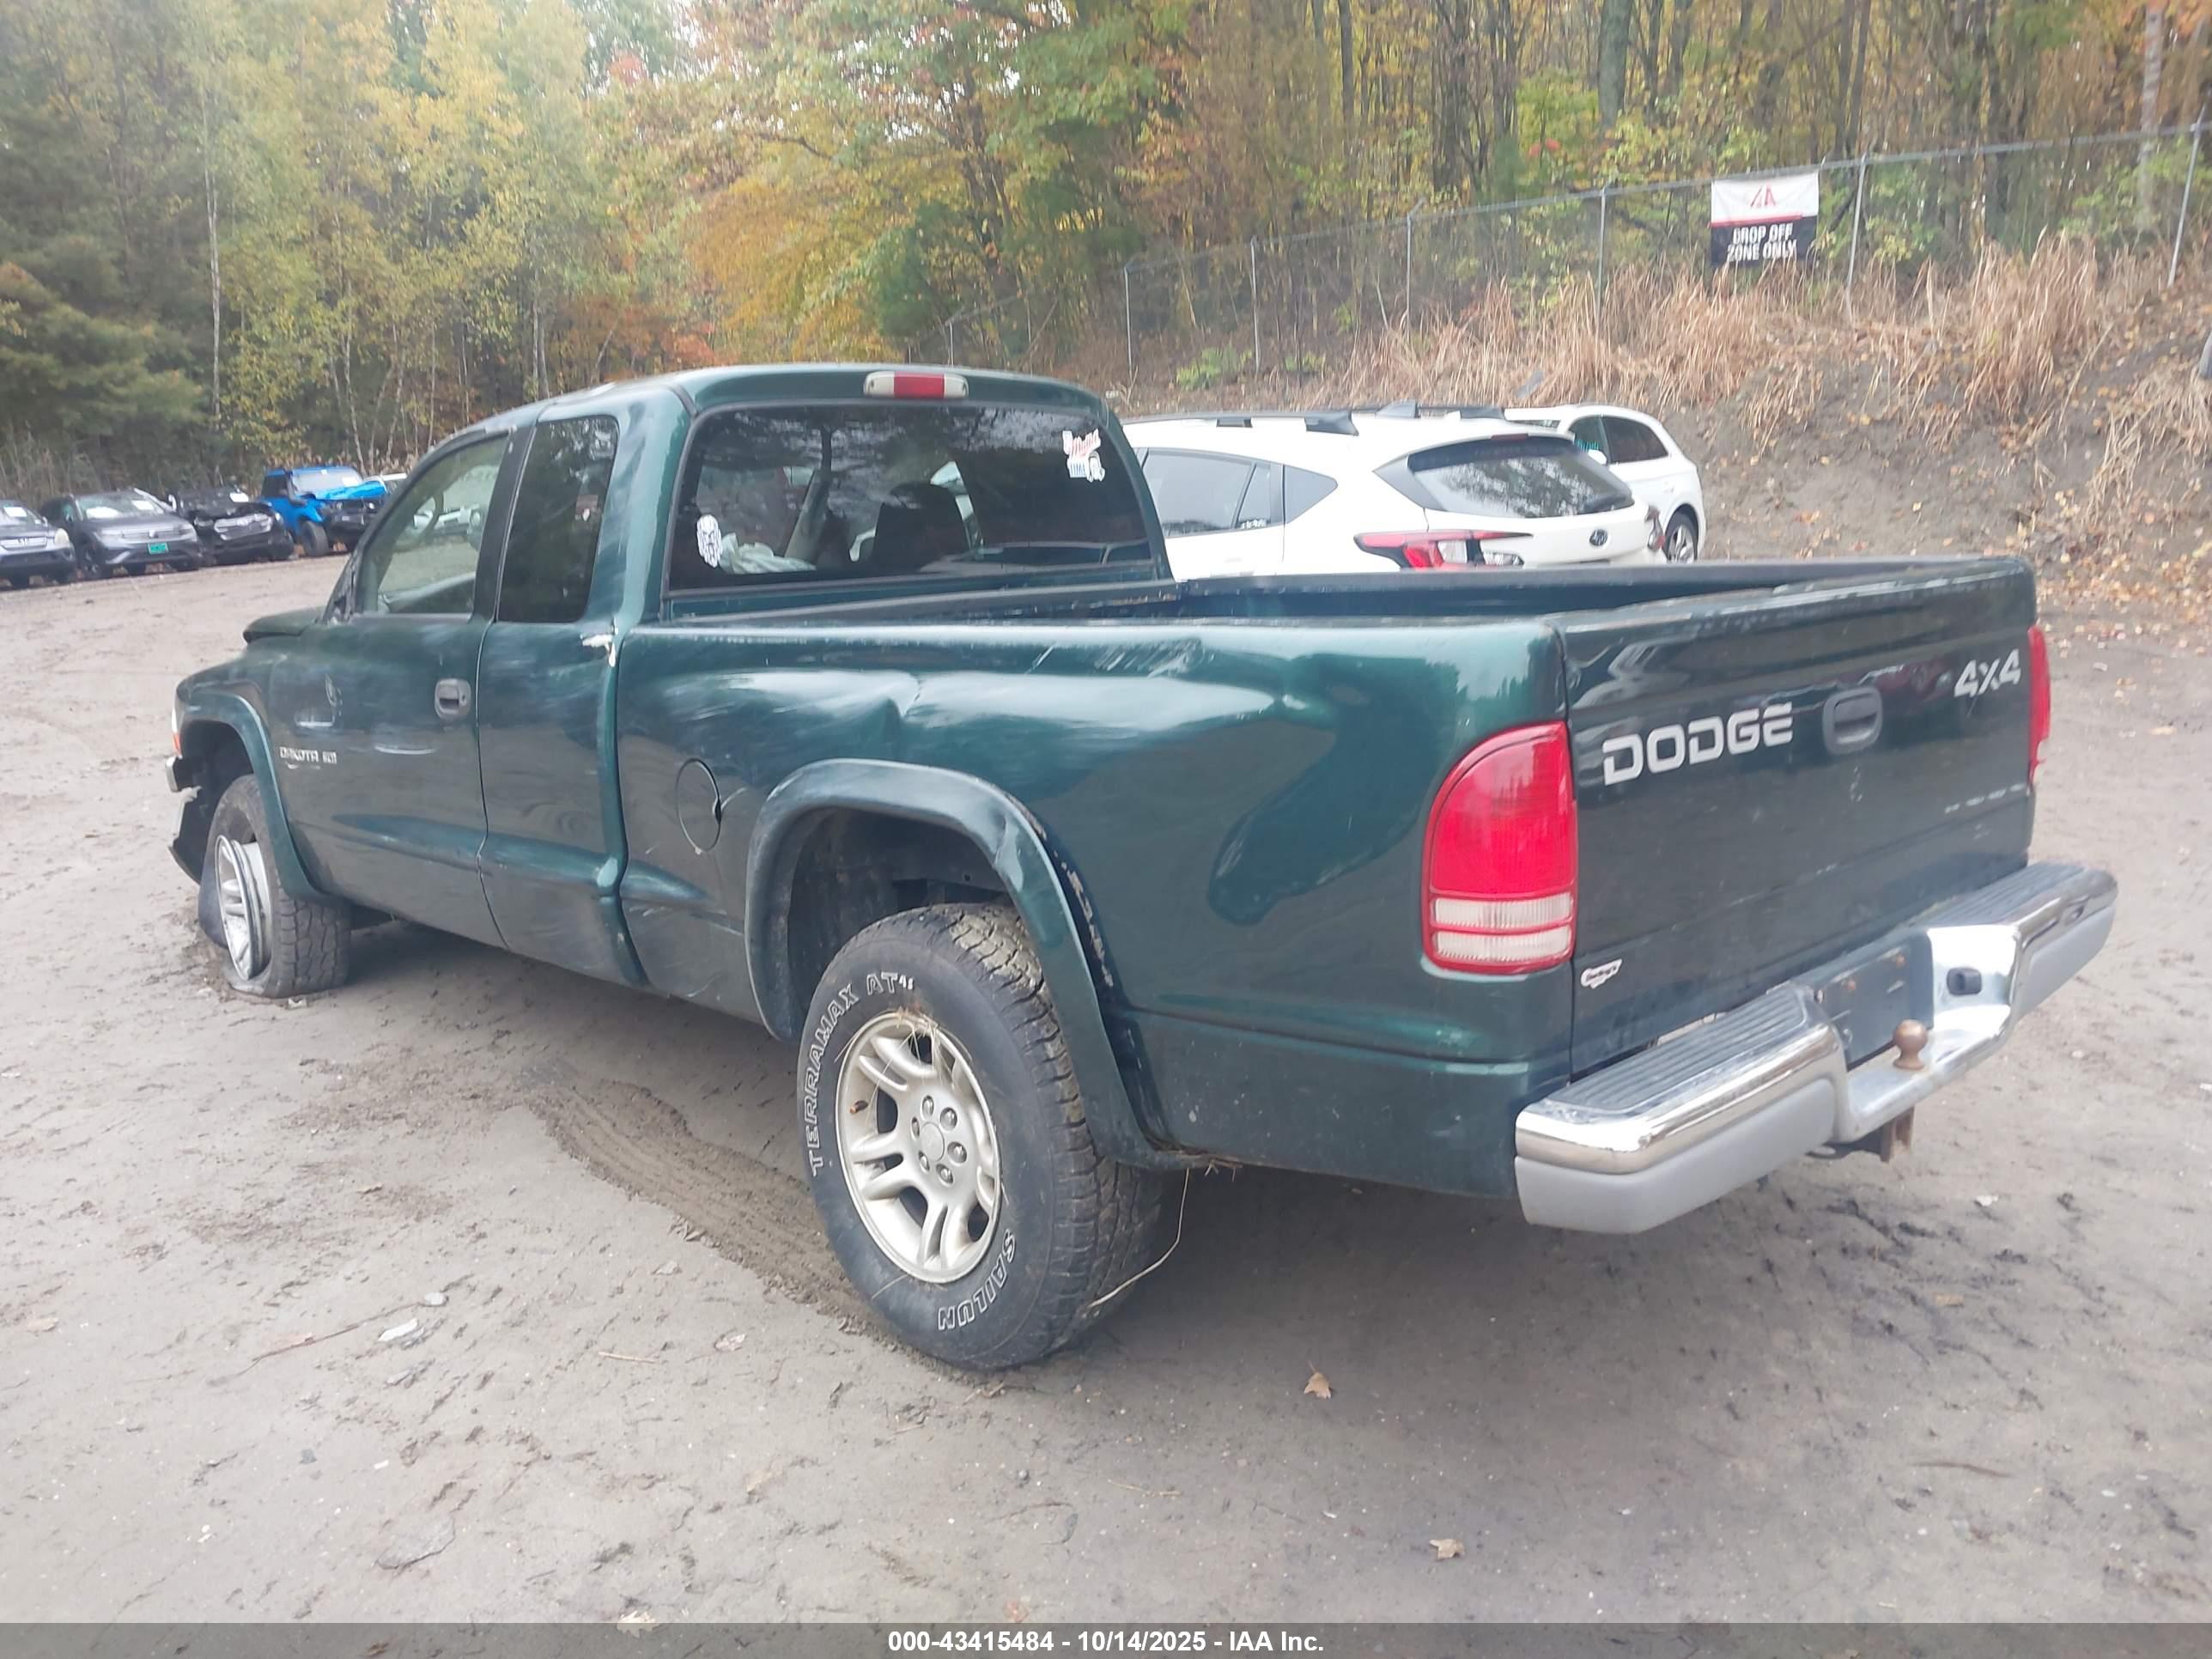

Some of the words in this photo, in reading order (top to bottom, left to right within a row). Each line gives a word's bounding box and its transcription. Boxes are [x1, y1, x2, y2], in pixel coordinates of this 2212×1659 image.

[1727, 242, 1760, 262] ZONE
[1762, 239, 1797, 259] ONLY
[1733, 226, 1766, 245] DROP
[1769, 222, 1793, 241] OFF
[1602, 702, 1793, 786] DODGE
[805, 983, 860, 1176] TERRAMAX
[938, 1228, 1016, 1330] SAILUN
